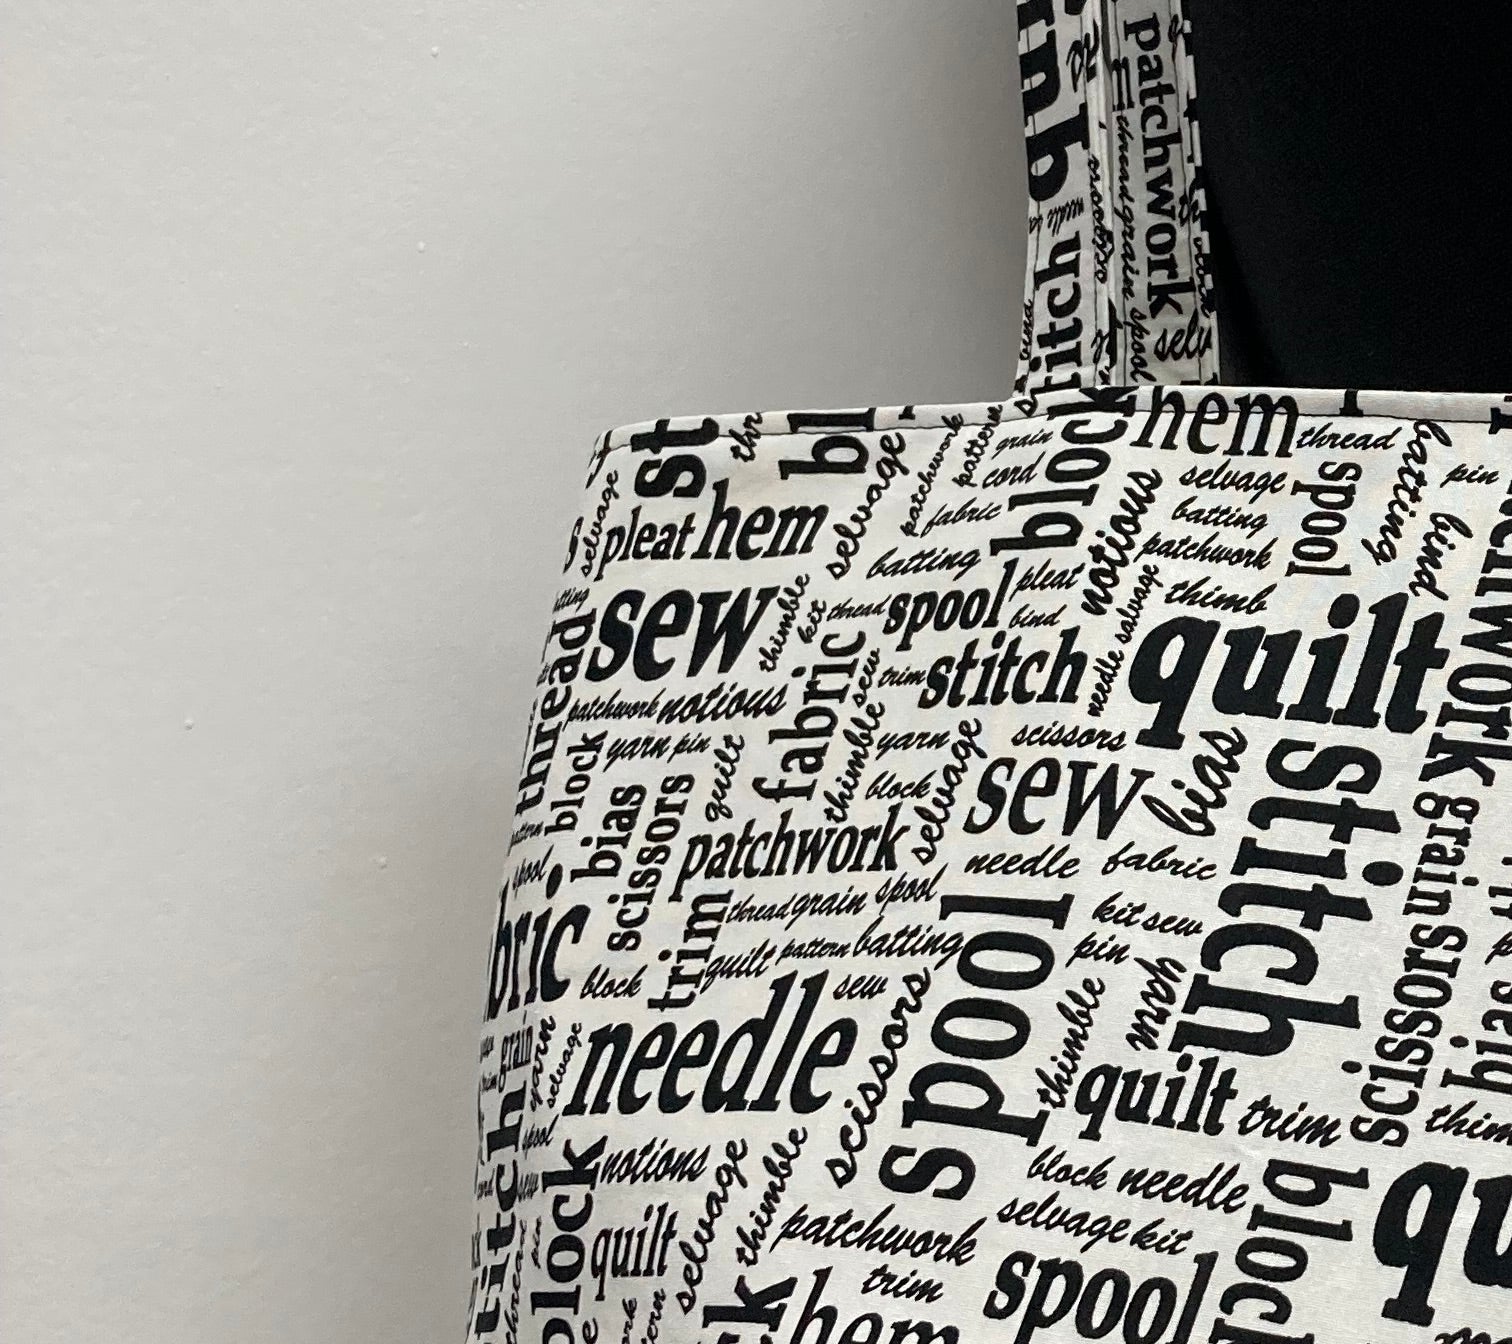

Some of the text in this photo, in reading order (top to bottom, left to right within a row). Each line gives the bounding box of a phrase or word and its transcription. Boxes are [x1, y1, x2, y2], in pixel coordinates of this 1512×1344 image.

[1122, 11, 1185, 320] patchwork
[690, 478, 829, 560] hem
[986, 386, 1138, 556] block
[585, 585, 780, 682] sew
[759, 574, 810, 672] thimble
[881, 554, 1019, 652] spool
[514, 608, 601, 816] thread
[752, 631, 871, 806] fabric
[917, 625, 1088, 709] stitch
[1128, 588, 1450, 750] quilt
[824, 702, 885, 823] thimble
[962, 757, 1155, 840] sew
[603, 774, 695, 951] scissors
[668, 802, 911, 903] patchwork
[1163, 731, 1403, 1057] stitch
[1402, 792, 1480, 915] grain
[562, 964, 858, 1116] needle
[825, 967, 931, 1189] scissors
[873, 886, 1079, 1200] spool
[1341, 924, 1469, 1147] scissors
[1074, 1053, 1238, 1142] quilt
[769, 1204, 987, 1266] patchwork
[1117, 1162, 1249, 1214] needle
